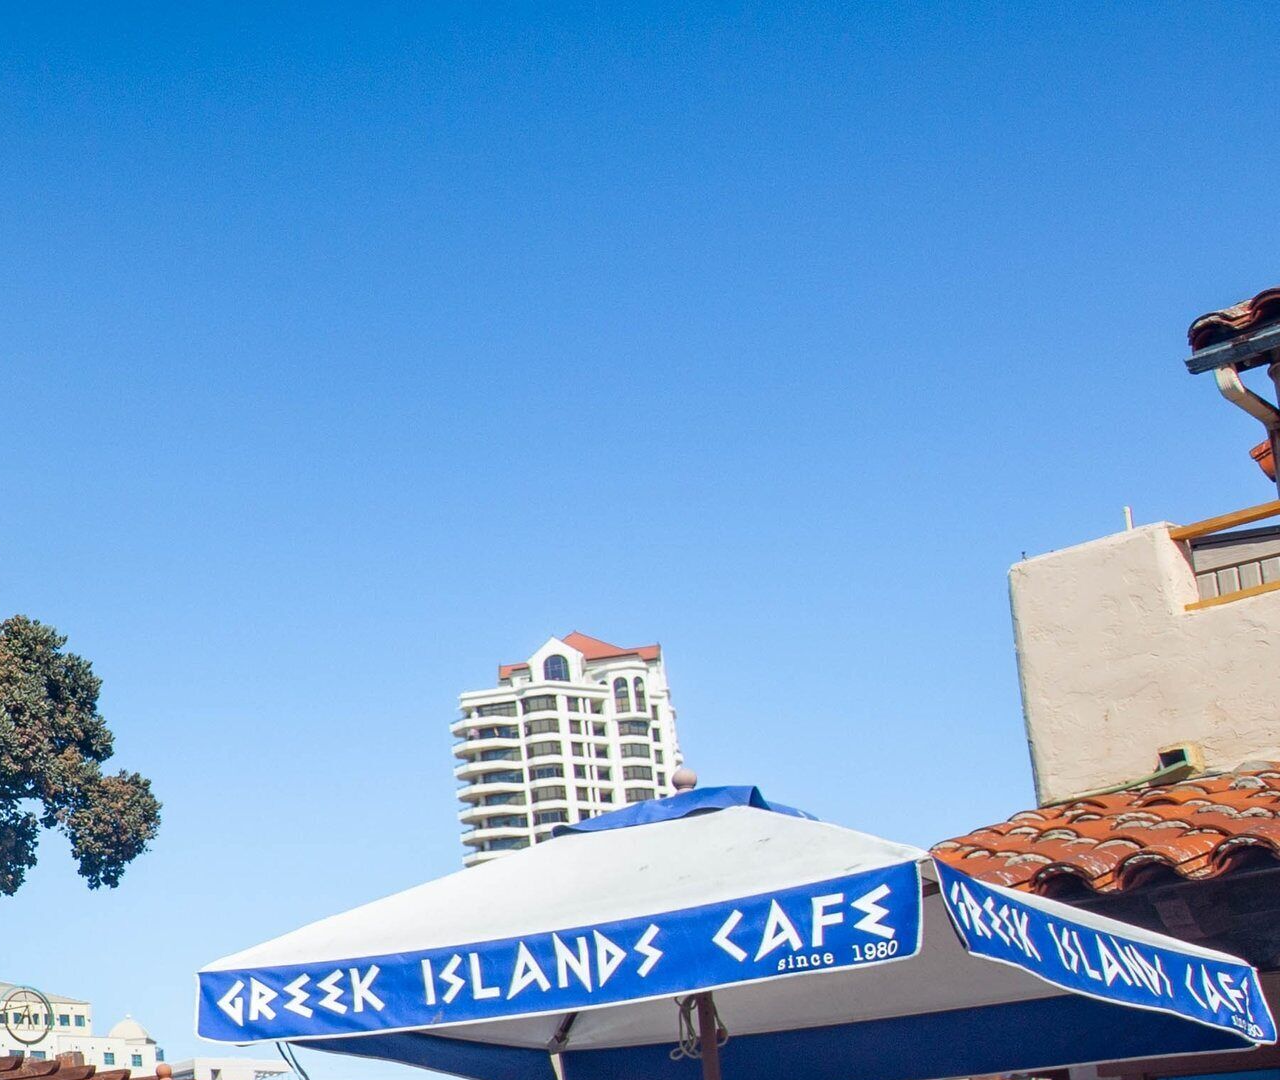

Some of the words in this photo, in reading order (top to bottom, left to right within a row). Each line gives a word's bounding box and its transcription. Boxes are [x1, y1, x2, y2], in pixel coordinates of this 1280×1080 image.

[217, 964, 387, 1028] GREEK
[422, 924, 663, 1006] ISLANDS
[712, 884, 898, 963] CAFE
[777, 951, 834, 971] since
[853, 940, 899, 962] 1980
[951, 881, 1041, 962] GREEK
